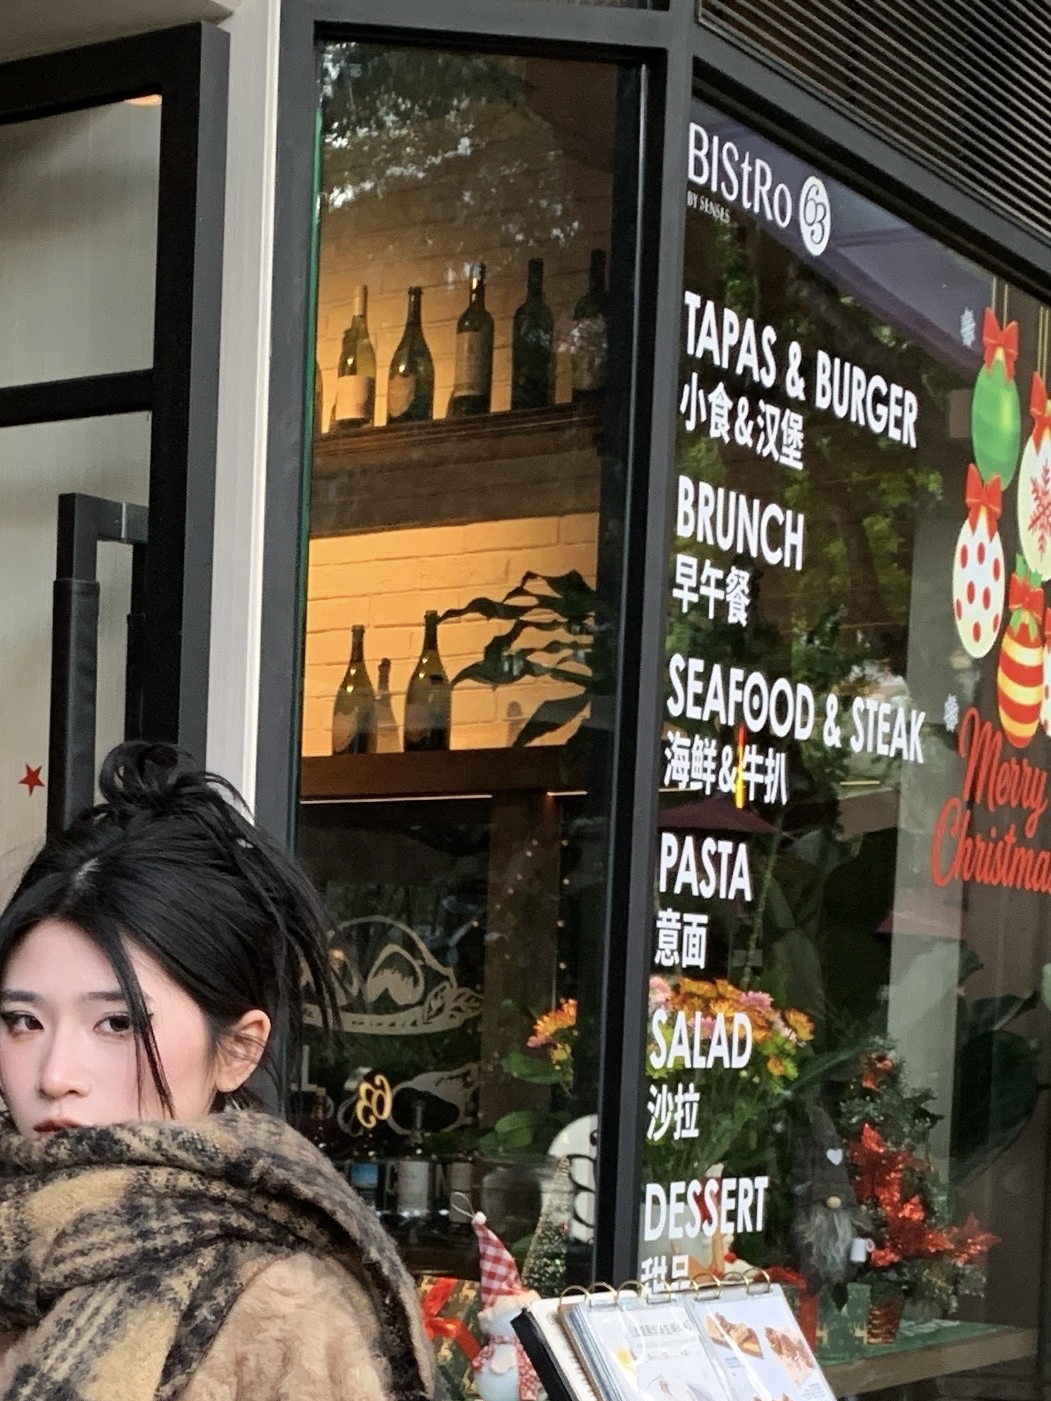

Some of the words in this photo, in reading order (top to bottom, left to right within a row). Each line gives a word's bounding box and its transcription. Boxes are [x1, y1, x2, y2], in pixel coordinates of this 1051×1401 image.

[685, 290, 777, 389] TAPAS
[785, 341, 806, 402] &
[816, 350, 919, 448] BURGER
[679, 371, 805, 471] 小食&汉堡
[676, 474, 805, 571] BRUNCH
[672, 555, 750, 627] 早午餐
[667, 654, 815, 742] SEAFOOD
[822, 694, 842, 749] &
[850, 697, 926, 764] STEAK
[663, 731, 789, 806] 海鲜&牛扒
[958, 706, 1048, 838] Merry
[660, 833, 752, 902] PASTA
[932, 796, 1051, 895] Christma
[654, 909, 709, 970] 意面
[649, 1010, 753, 1071] SALAD
[646, 1084, 700, 1142] 沙拉
[643, 1175, 769, 1242] DESSERT
[639, 1254, 691, 1293] 甜品
